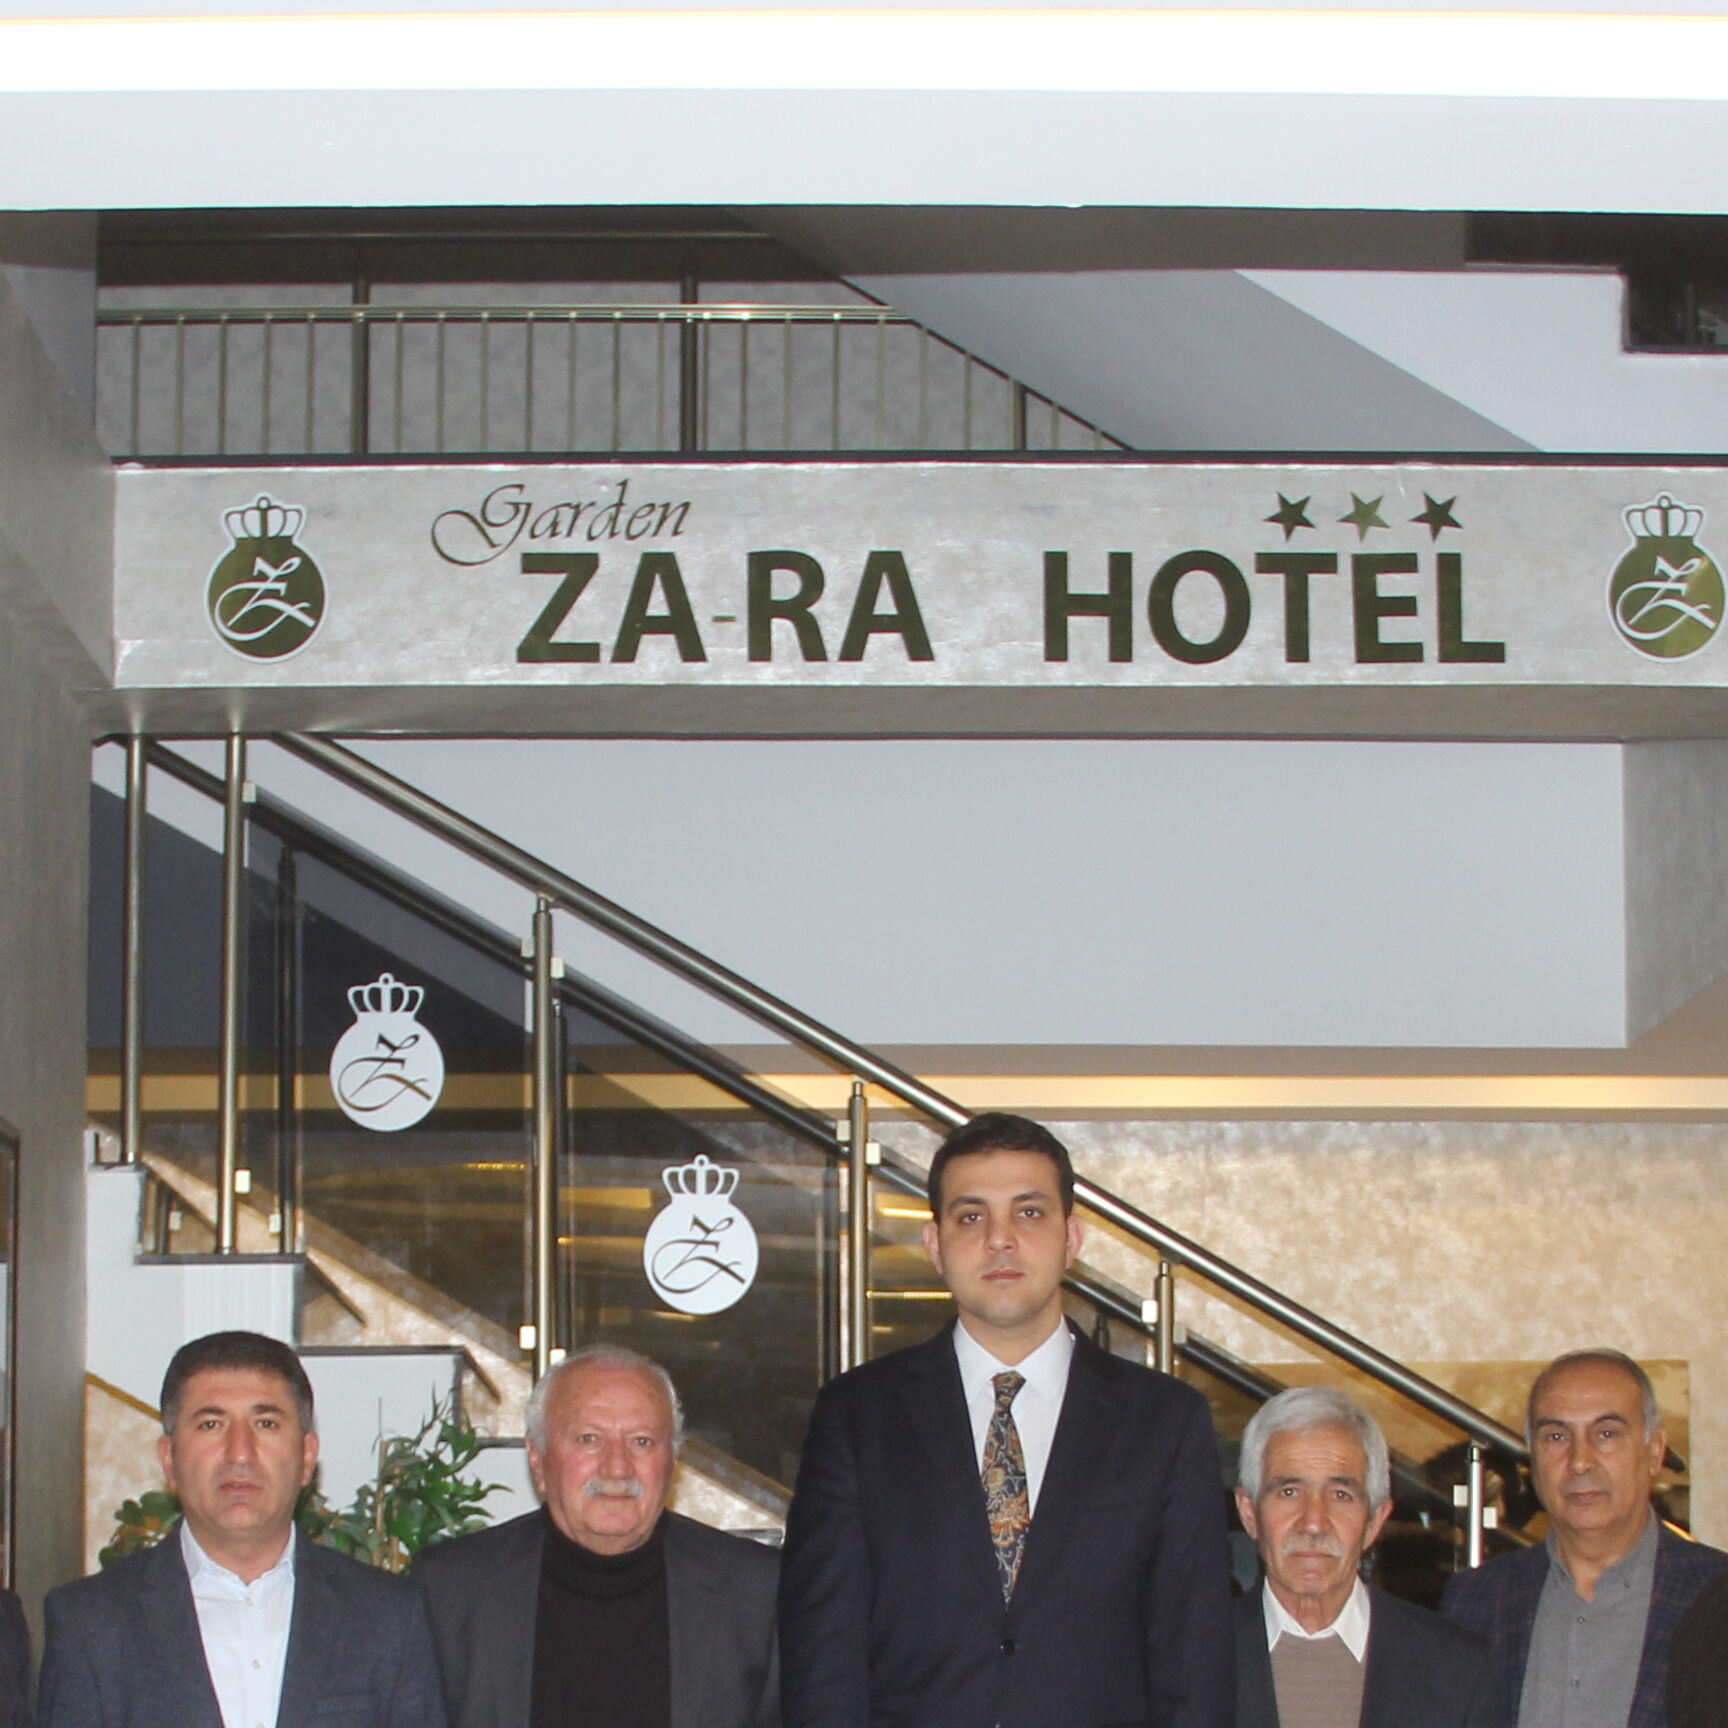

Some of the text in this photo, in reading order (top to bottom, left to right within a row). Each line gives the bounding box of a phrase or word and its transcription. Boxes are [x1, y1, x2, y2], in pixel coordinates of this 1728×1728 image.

[430, 479, 692, 567] Garden
[516, 549, 1507, 665] ZA-RA HOTEL
